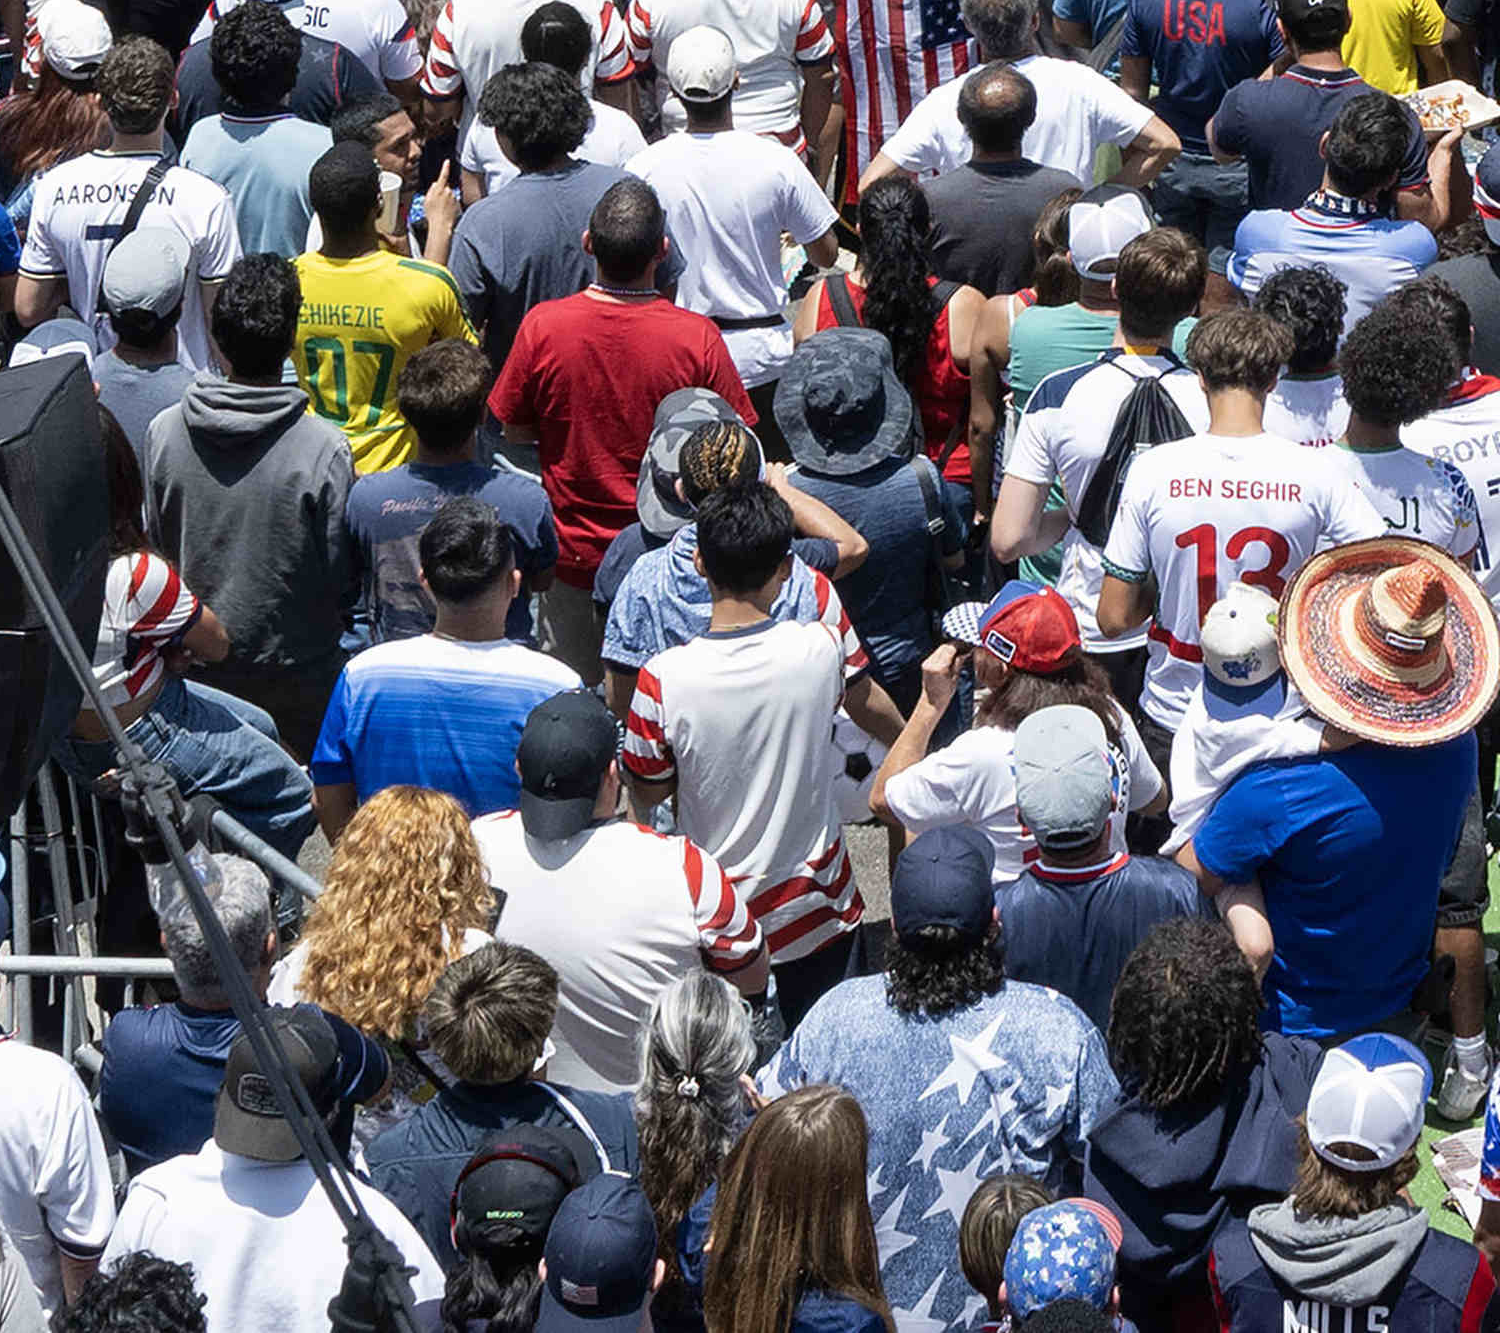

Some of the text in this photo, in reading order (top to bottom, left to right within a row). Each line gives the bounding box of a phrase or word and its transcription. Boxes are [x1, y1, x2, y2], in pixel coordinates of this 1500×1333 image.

[1168, 478, 1302, 503] BEN SEGHIR
[1174, 522, 1291, 632] 13
